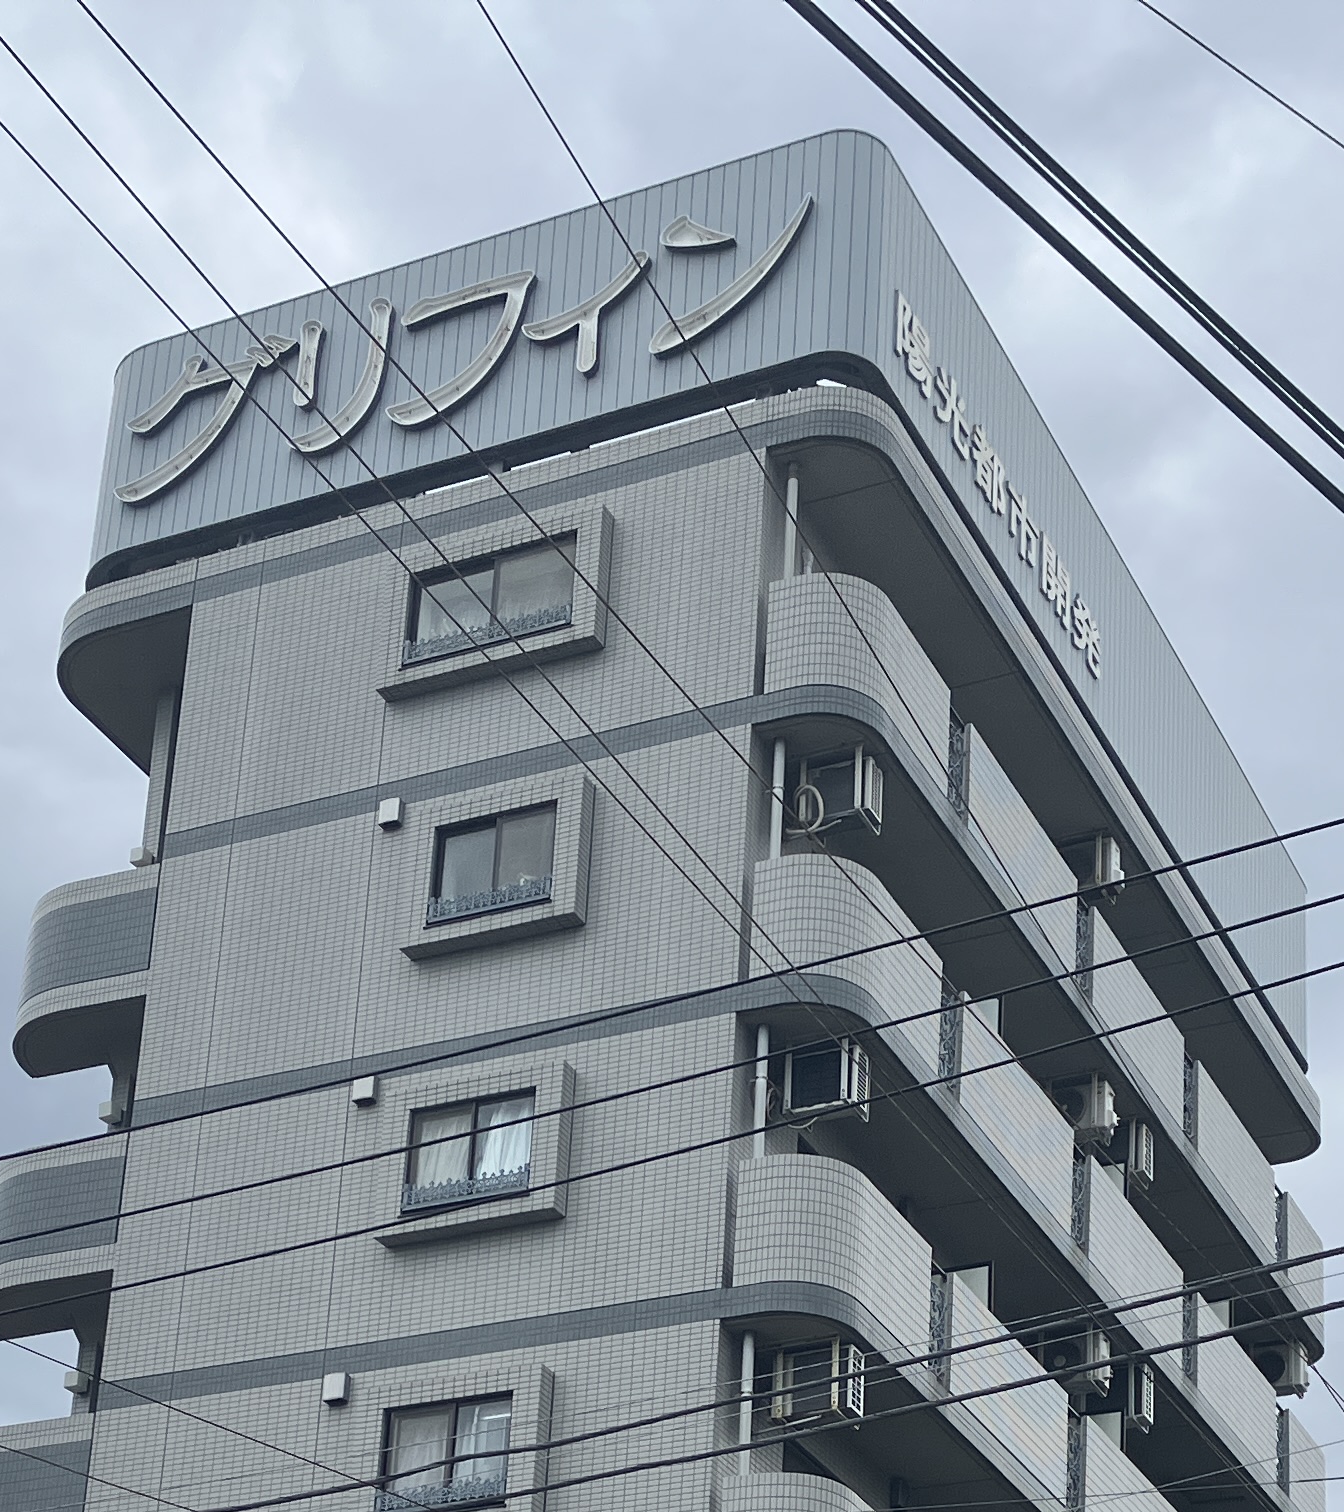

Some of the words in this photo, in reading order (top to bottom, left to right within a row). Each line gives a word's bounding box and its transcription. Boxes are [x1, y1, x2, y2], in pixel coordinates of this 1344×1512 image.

[894, 288, 1102, 680] 陽光都市開発
